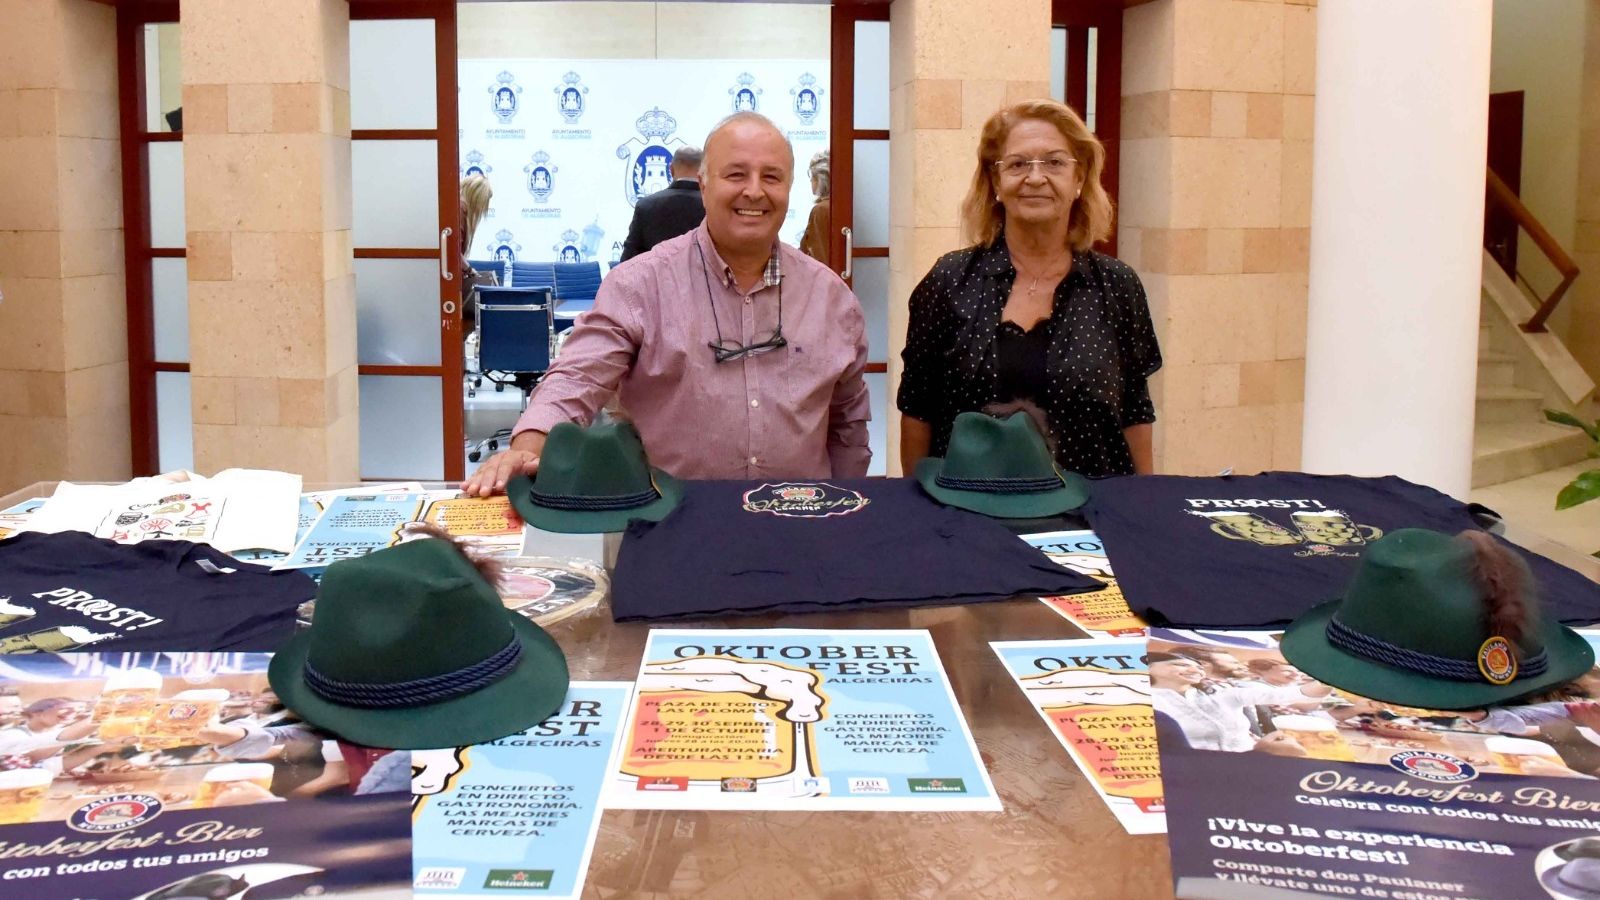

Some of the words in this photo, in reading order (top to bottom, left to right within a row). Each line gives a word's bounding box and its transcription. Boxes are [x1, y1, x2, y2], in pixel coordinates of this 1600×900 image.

[673, 645, 918, 659] OKTOBER
[806, 662, 920, 675] FEST
[483, 739, 602, 748] ALGECIRAS
[1299, 770, 1504, 803] Oktoberfest
[1512, 787, 1600, 812] Bier
[80, 795, 159, 811] PAULANER
[437, 801, 582, 809] GASTRONOMÍA.
[1295, 794, 1382, 812] Celebra
[1385, 804, 1429, 815] con
[1433, 806, 1500, 821] todos
[1502, 812, 1542, 826] tus
[165, 820, 264, 846] Bier
[451, 829, 546, 837] CERVEZA.
[1207, 817, 1285, 835] ¡Vive
[1291, 823, 1321, 839] la
[1324, 827, 1515, 856] experiencia
[1210, 835, 1410, 866] Oktoberfest!
[3, 867, 51, 880] con
[56, 859, 128, 875] todos
[133, 854, 173, 868] tus
[176, 847, 269, 864] amigos
[1213, 858, 1318, 878] Comparte
[1321, 869, 1361, 882] dos
[1362, 873, 1465, 892] Paulaner
[1312, 882, 1357, 895] uno
[1360, 886, 1389, 898] de
